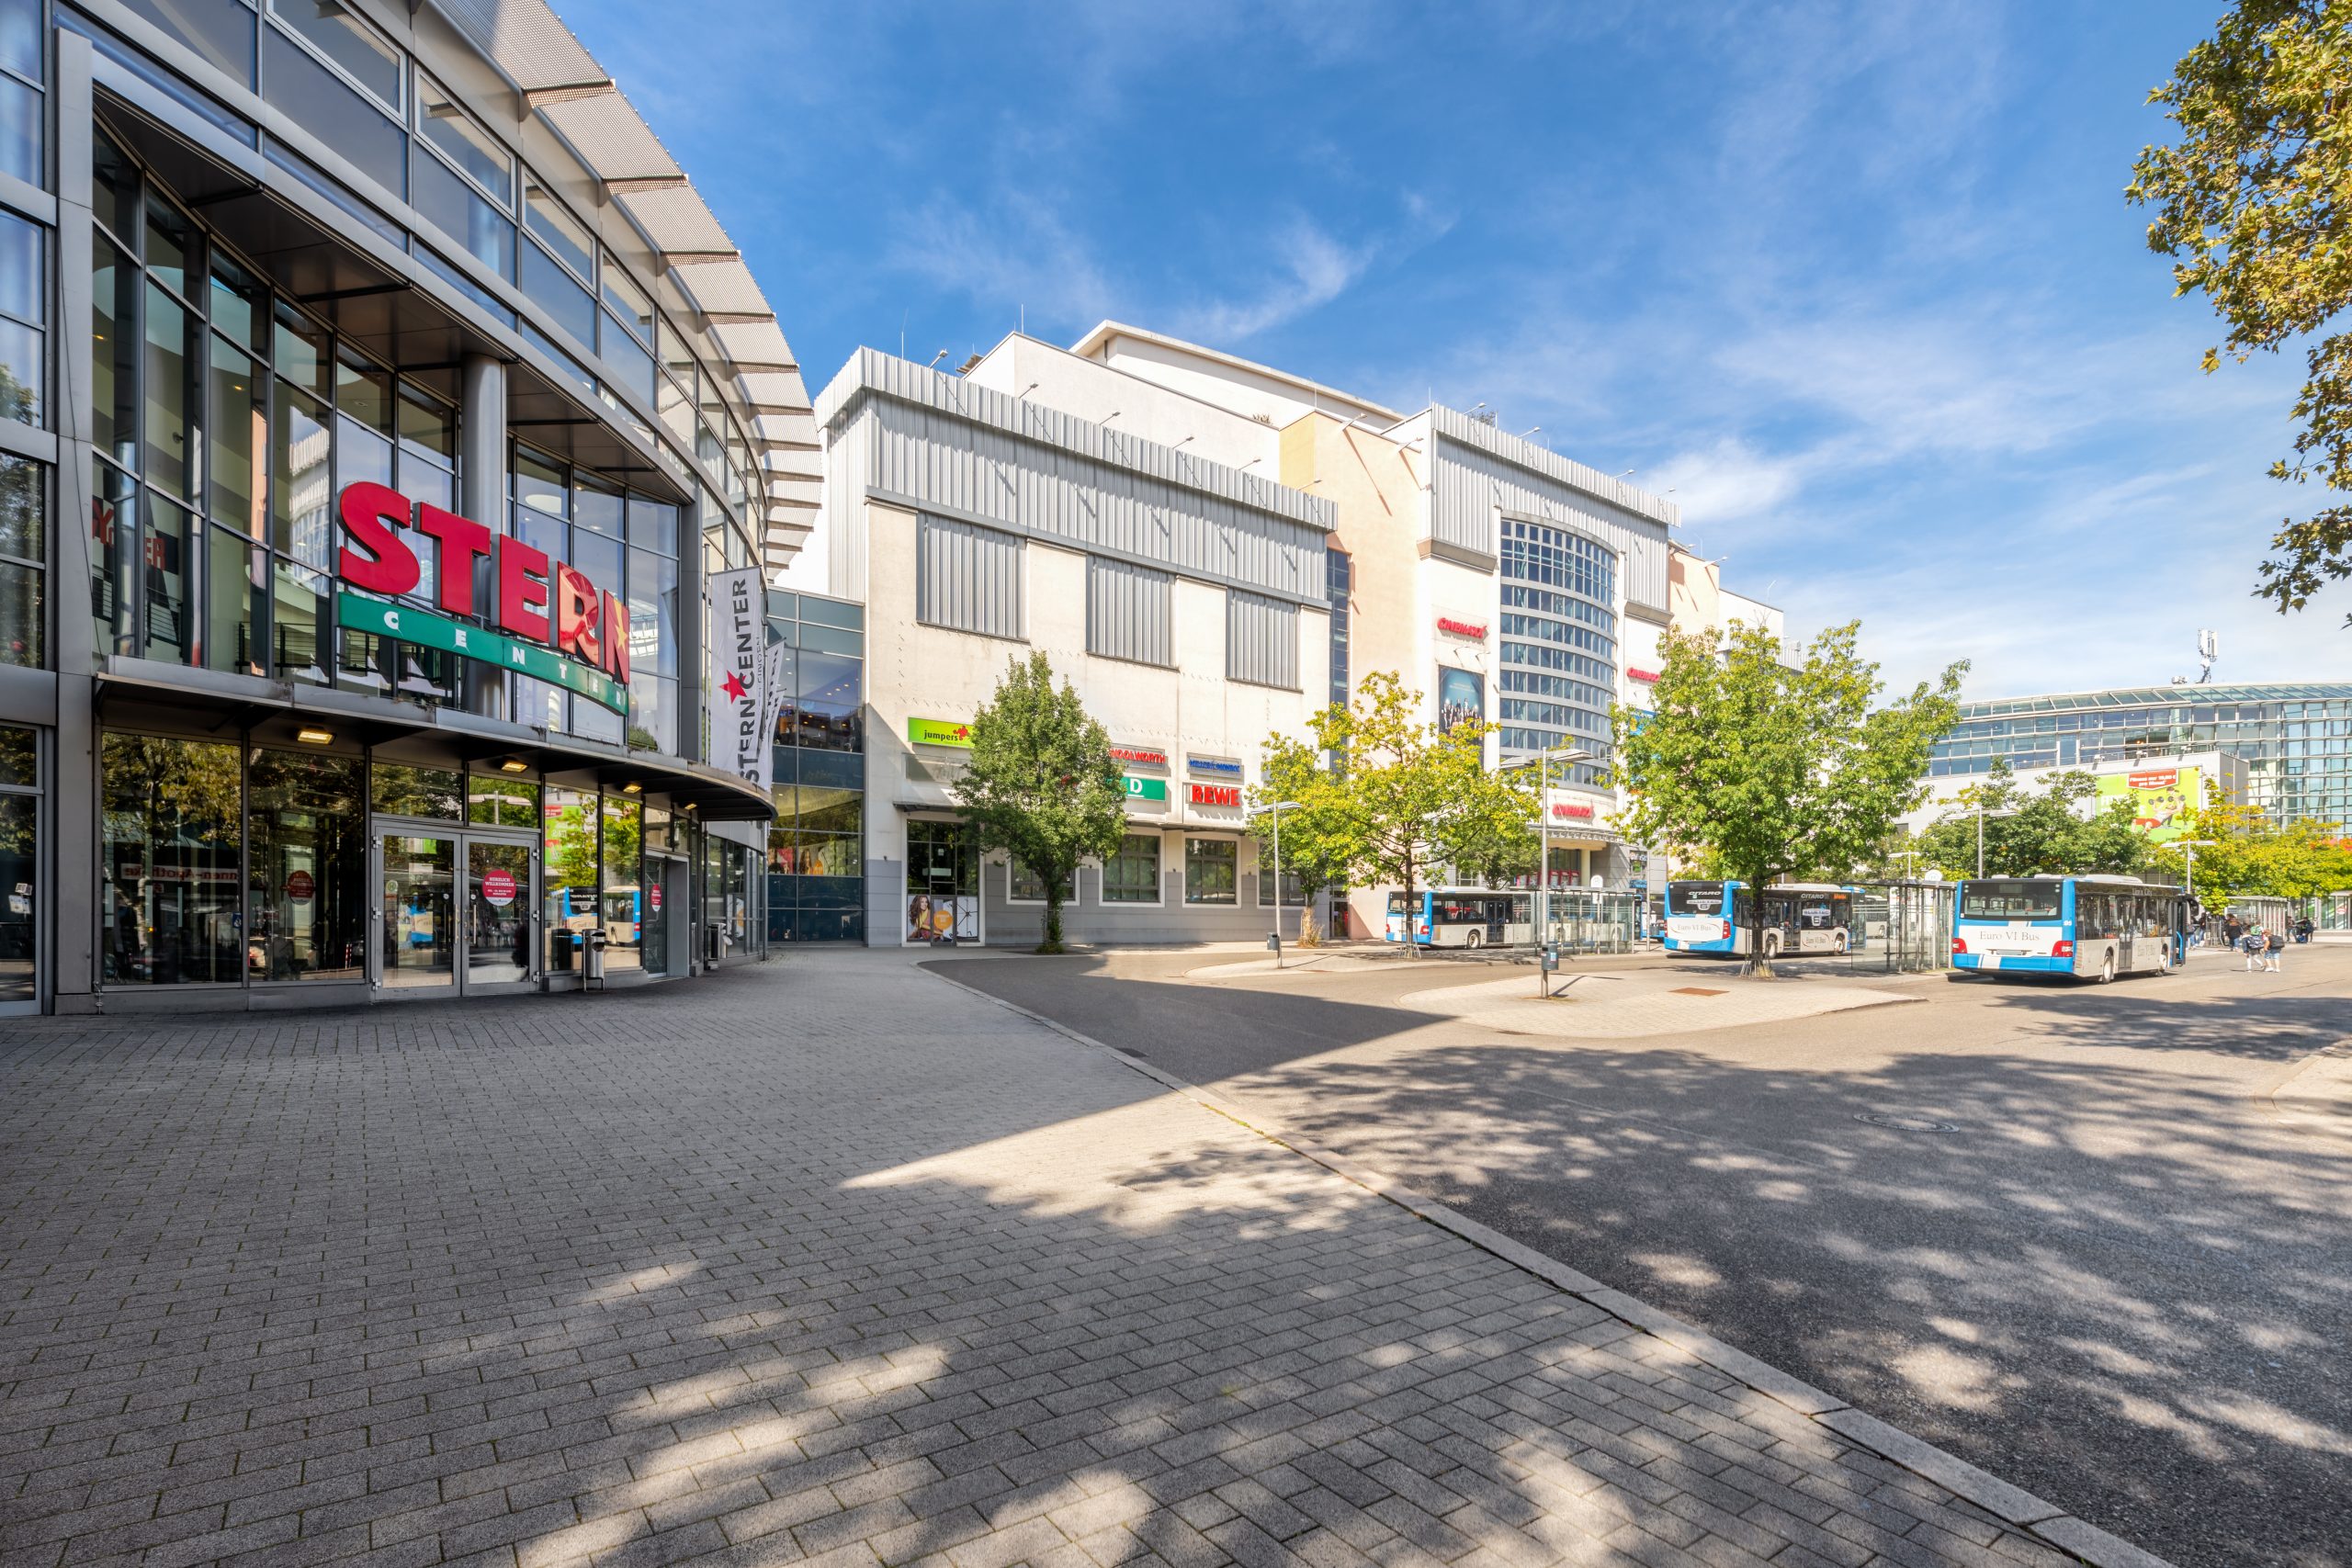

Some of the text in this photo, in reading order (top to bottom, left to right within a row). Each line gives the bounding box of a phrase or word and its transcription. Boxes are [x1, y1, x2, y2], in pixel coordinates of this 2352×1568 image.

[338, 481, 629, 685] STERN
[383, 612, 625, 706] CENTER
[733, 578, 761, 783] STERN CENTER
[924, 729, 958, 741] jumpers
[1192, 784, 1240, 807] REWE
[1979, 931, 2040, 942] Euro VI Bus
